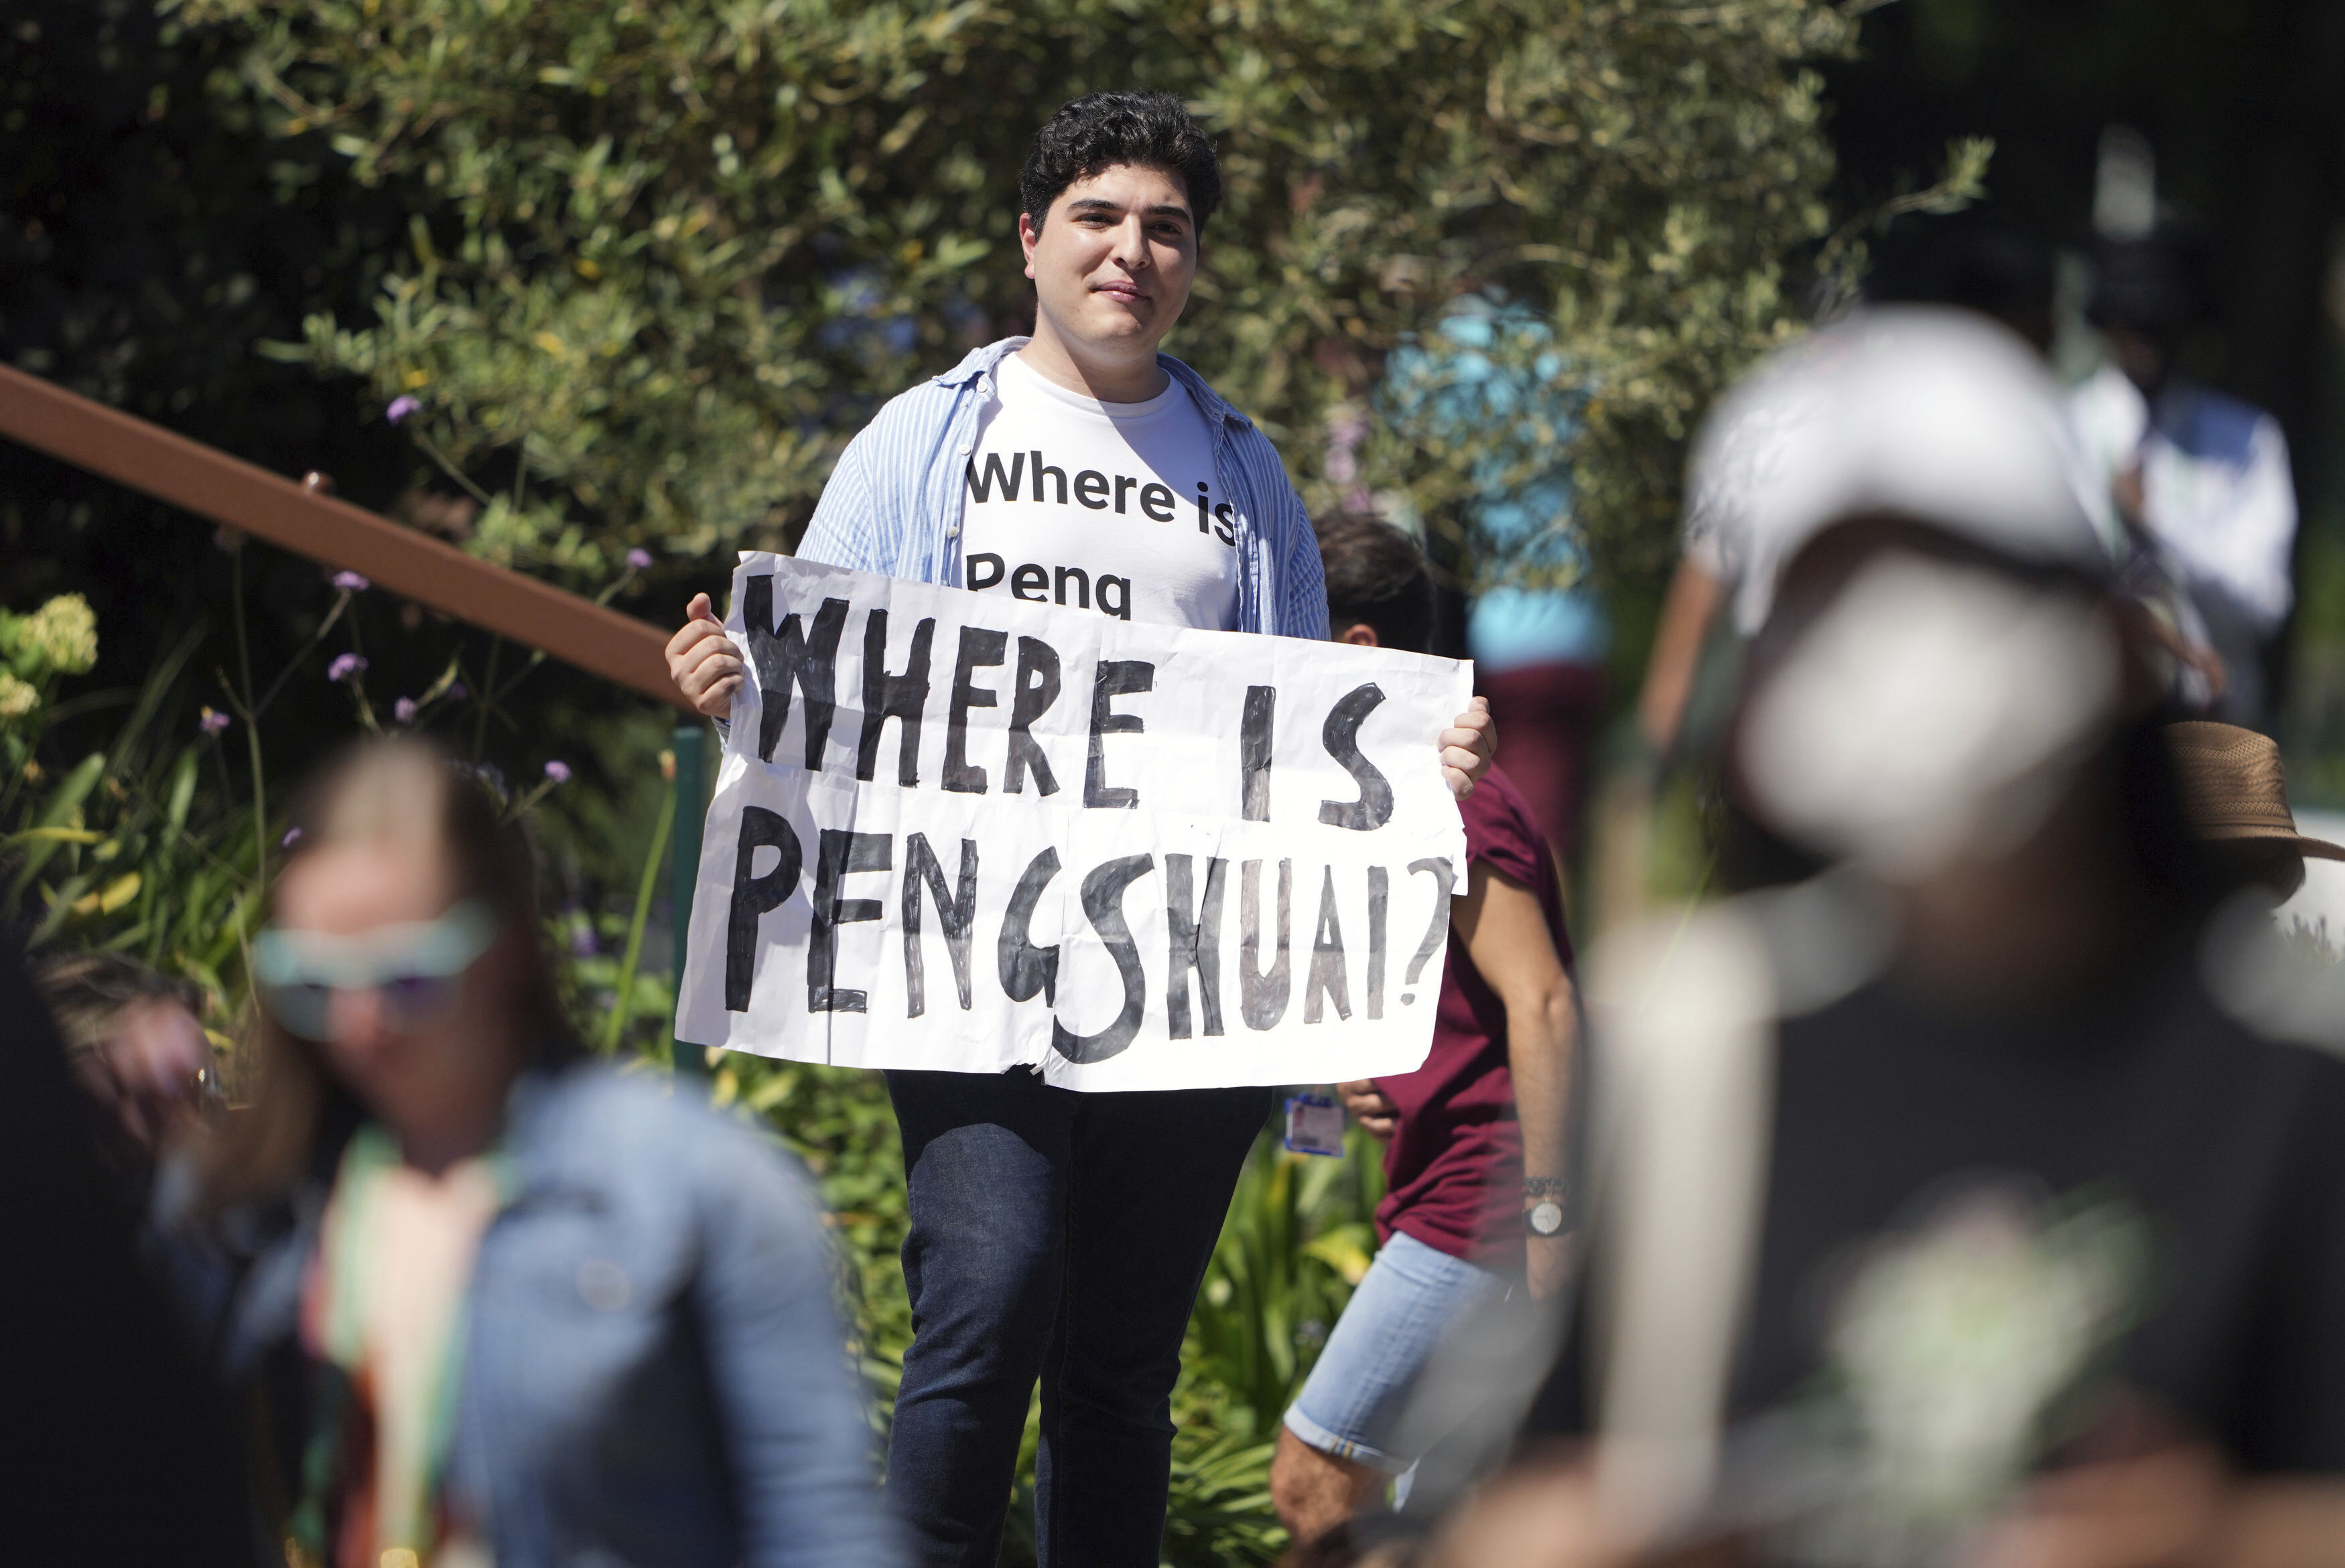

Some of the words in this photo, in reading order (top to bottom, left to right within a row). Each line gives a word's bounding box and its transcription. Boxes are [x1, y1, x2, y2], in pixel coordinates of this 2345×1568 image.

[965, 450, 1176, 522] Where
[1197, 481, 1236, 547] is
[744, 574, 1156, 809] WHERE
[1241, 681, 1394, 831] IS
